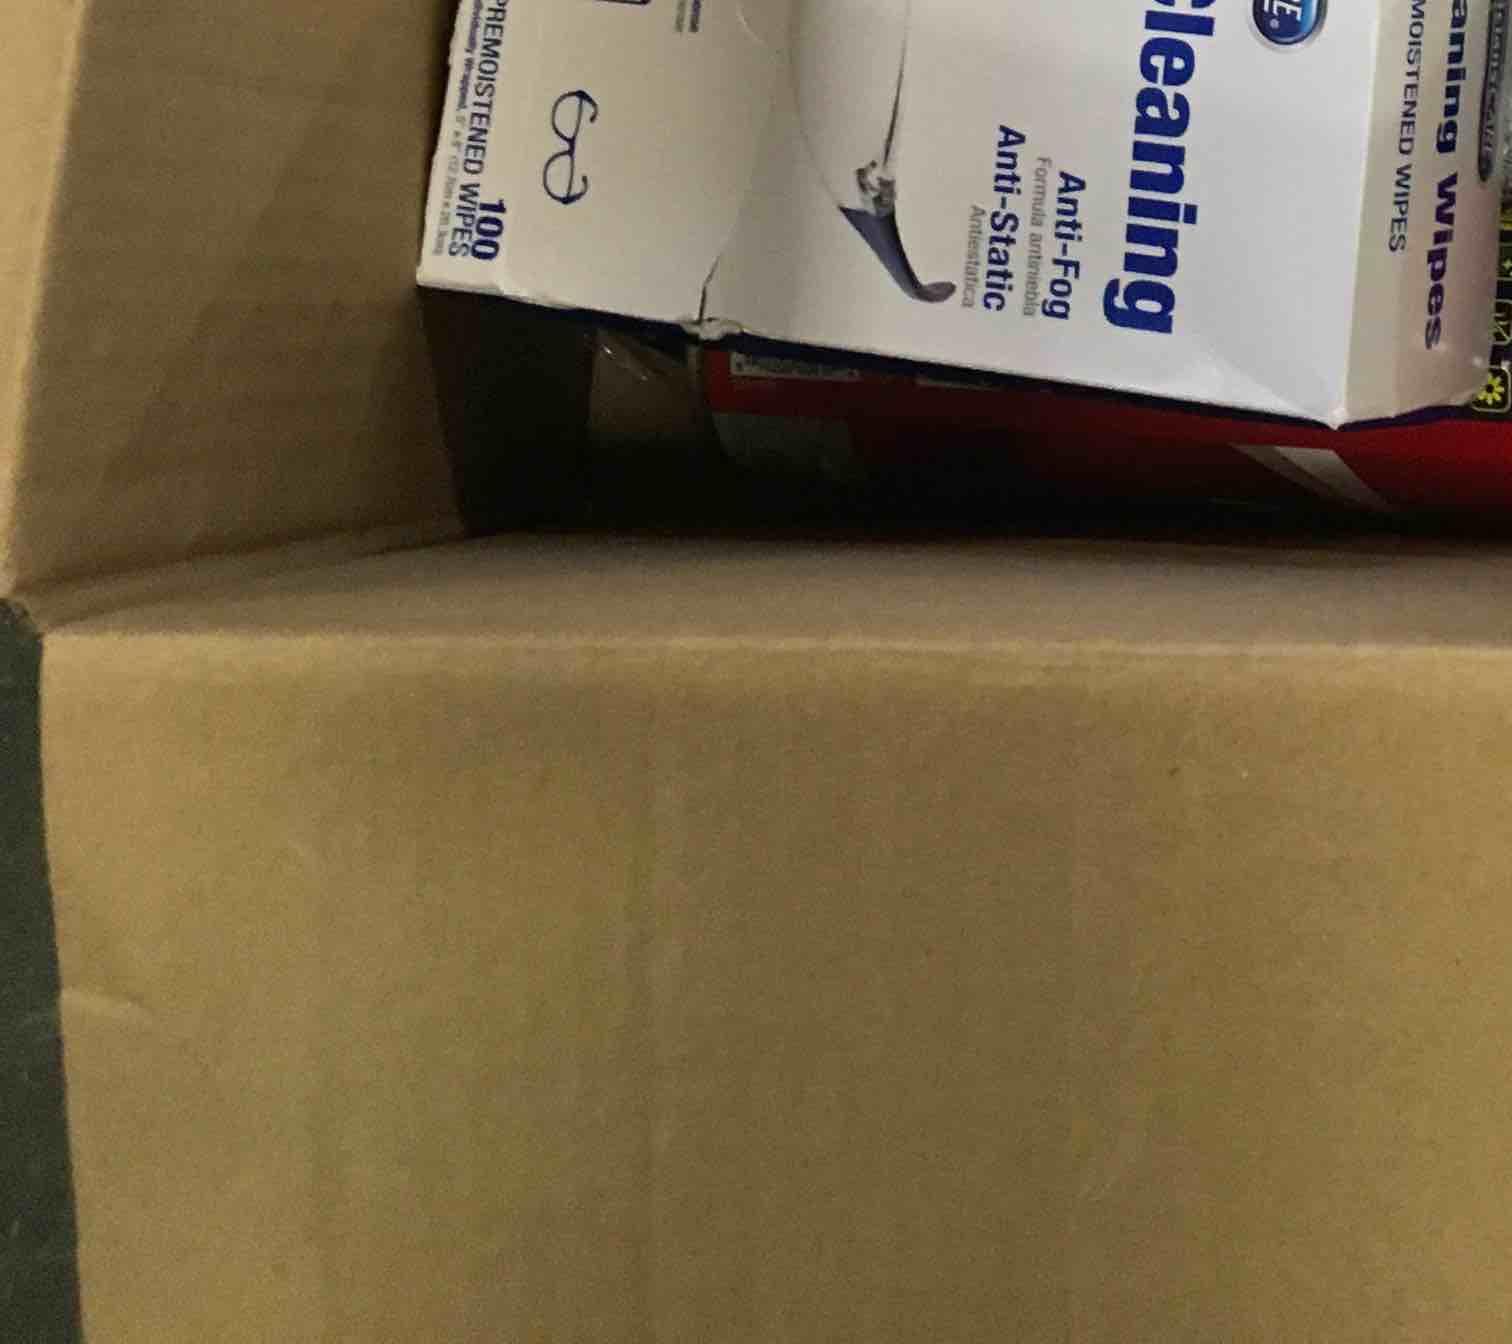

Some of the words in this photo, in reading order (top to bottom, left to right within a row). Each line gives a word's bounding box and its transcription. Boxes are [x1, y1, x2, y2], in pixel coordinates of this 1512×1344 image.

[448, 182, 481, 257] WIPES
[470, 199, 507, 261] 100
[983, 125, 1026, 312] Anti-Static
[1041, 171, 1086, 320] Anti-Fog
[1387, 159, 1413, 253] WIPES
[1424, 171, 1459, 351] Wipes
